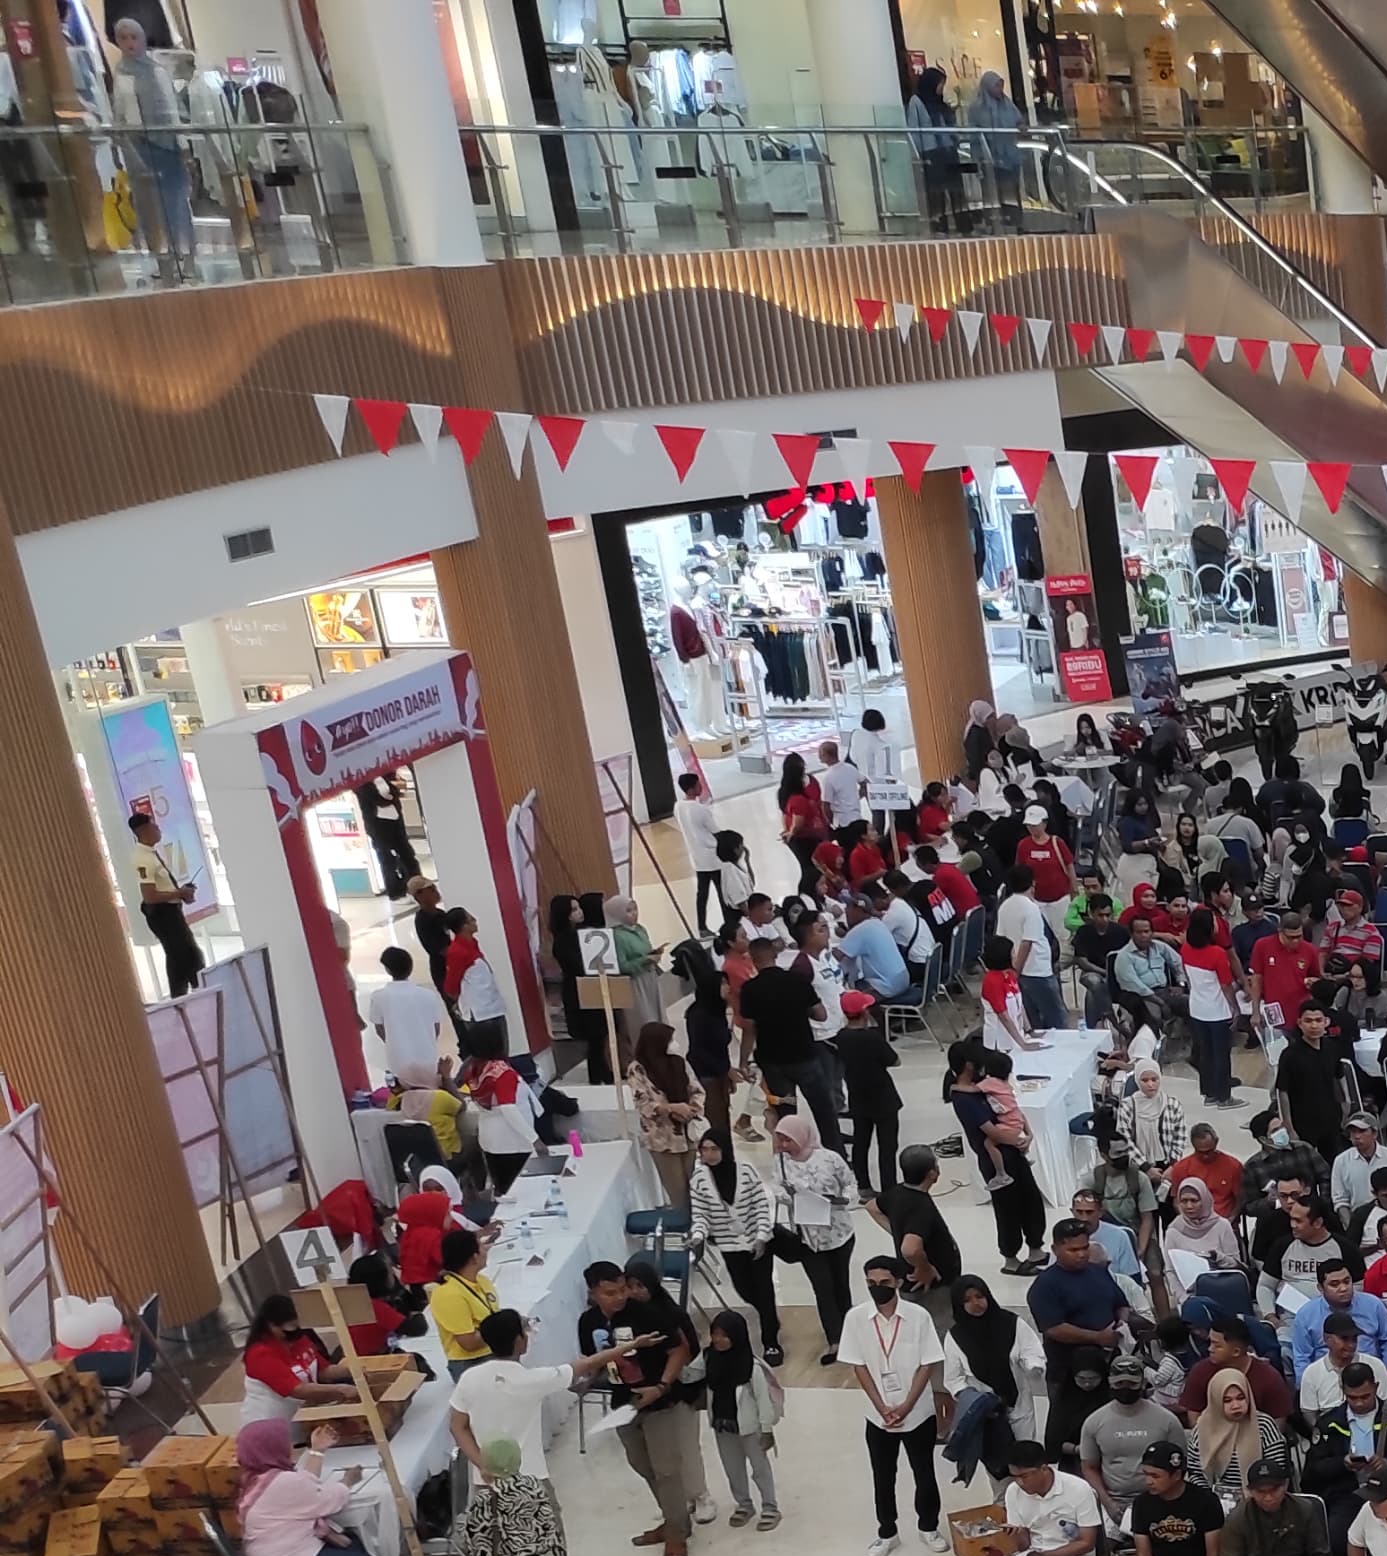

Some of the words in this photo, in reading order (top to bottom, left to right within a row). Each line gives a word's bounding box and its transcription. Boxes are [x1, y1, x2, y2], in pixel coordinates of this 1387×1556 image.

[365, 704, 403, 732] DONOR
[403, 685, 441, 715] DARAH
[296, 1230, 336, 1277] 4
[1288, 1258, 1324, 1273] FREE
